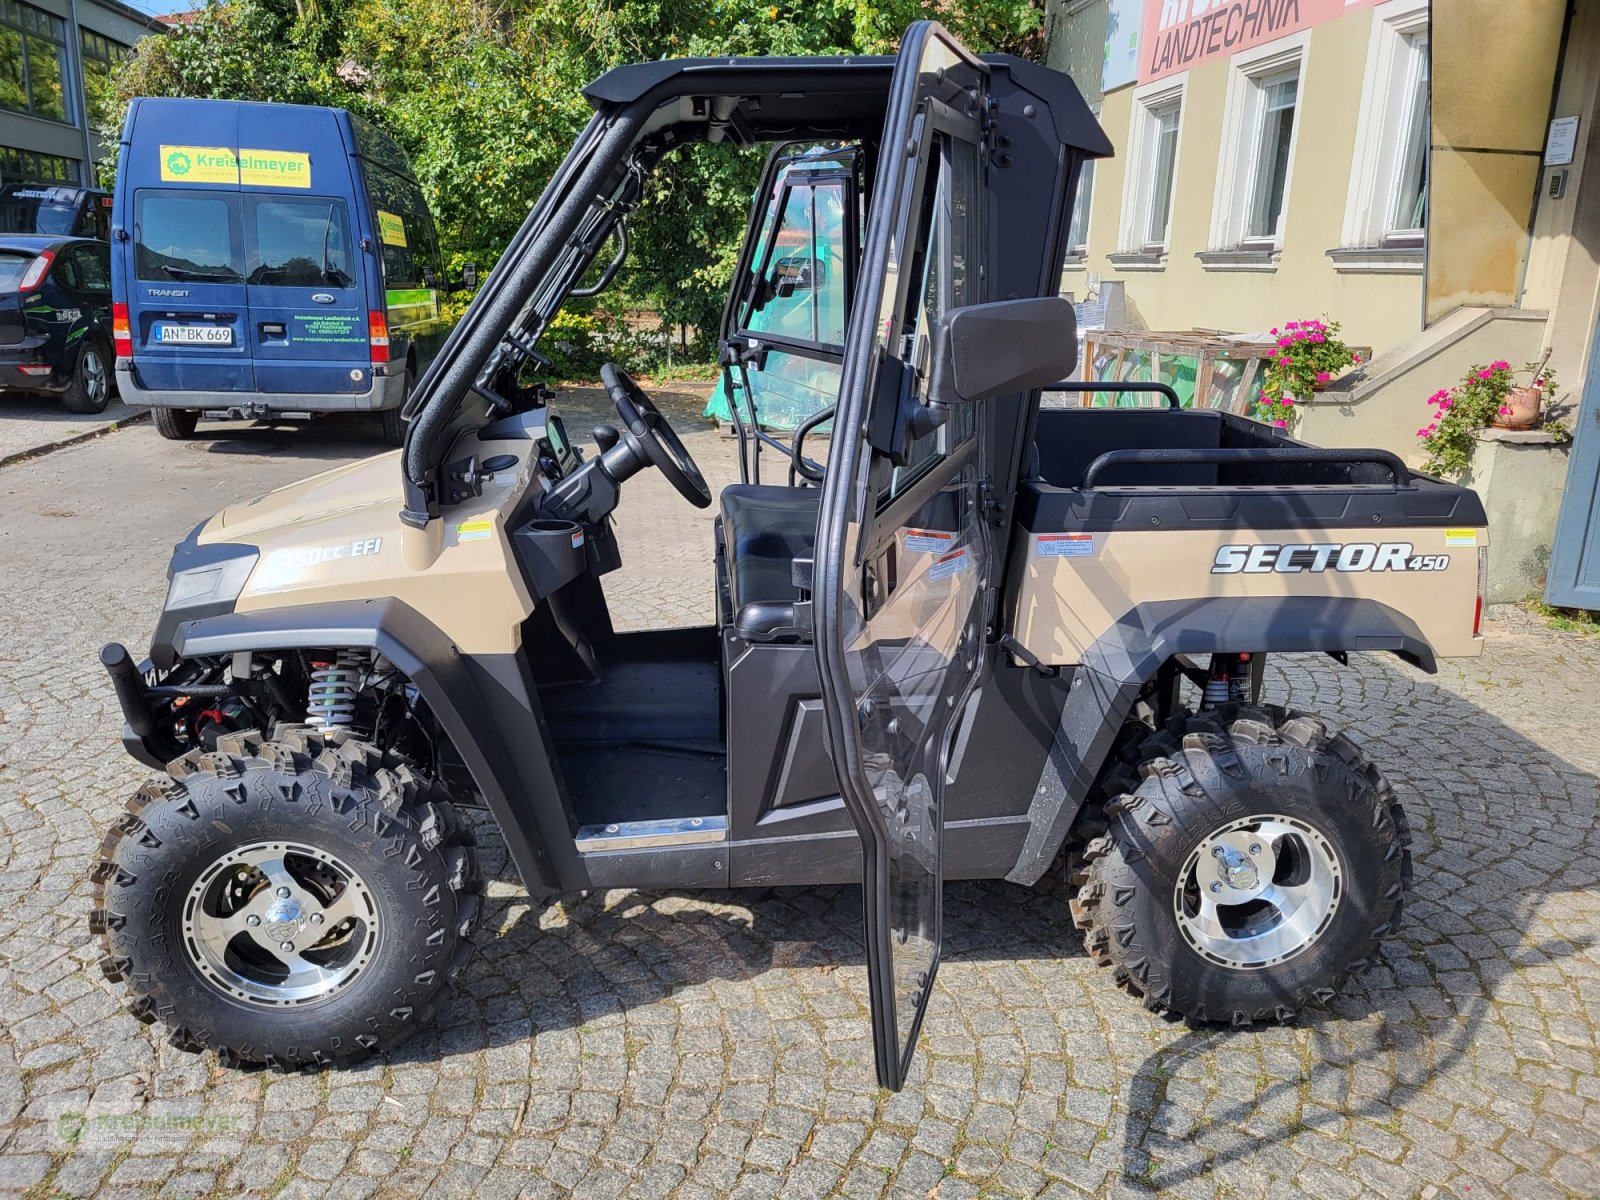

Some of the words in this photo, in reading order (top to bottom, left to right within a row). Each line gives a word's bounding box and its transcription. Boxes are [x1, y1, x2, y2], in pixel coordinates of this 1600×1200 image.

[196, 152, 305, 172] Kreiselmeyer
[147, 288, 190, 297] TRANSIT
[163, 327, 180, 340] AN
[187, 328, 204, 341] BK
[206, 329, 230, 341] 669
[349, 537, 383, 558] EFI
[1210, 542, 1413, 573] SECTOR
[1408, 554, 1450, 571] 450
